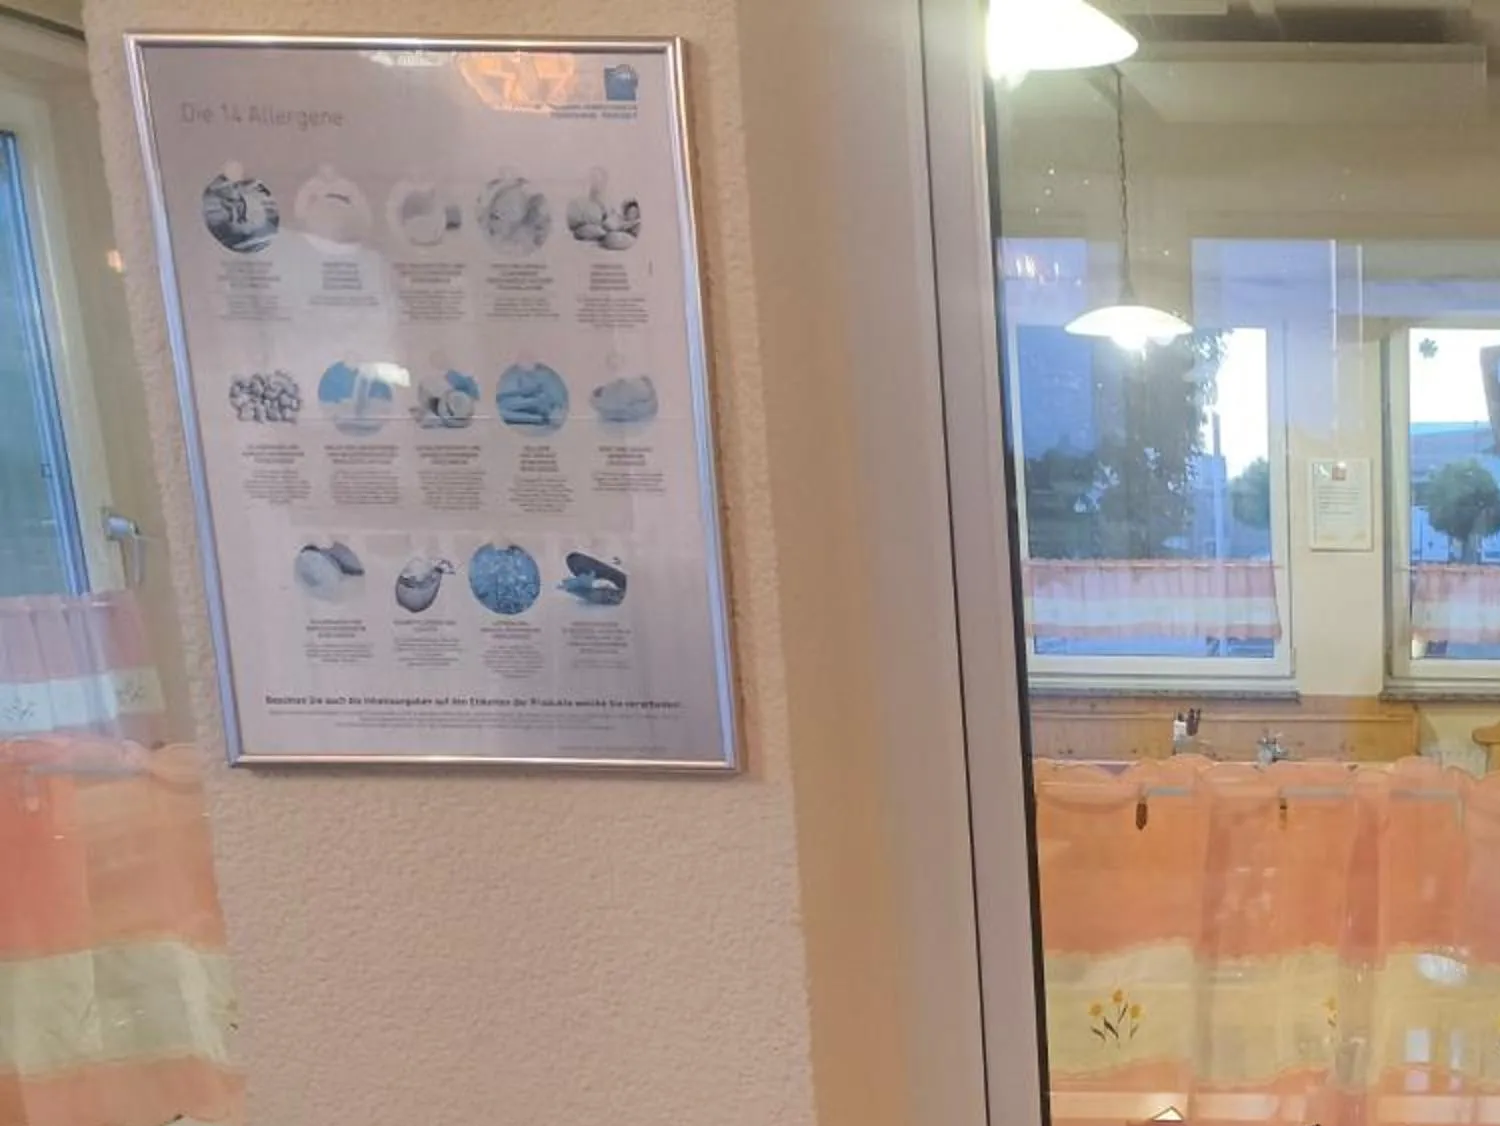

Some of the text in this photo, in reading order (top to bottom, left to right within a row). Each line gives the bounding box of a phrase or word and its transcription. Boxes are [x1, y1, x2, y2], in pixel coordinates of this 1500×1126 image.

[181, 101, 345, 132] Die 14 Allergene
